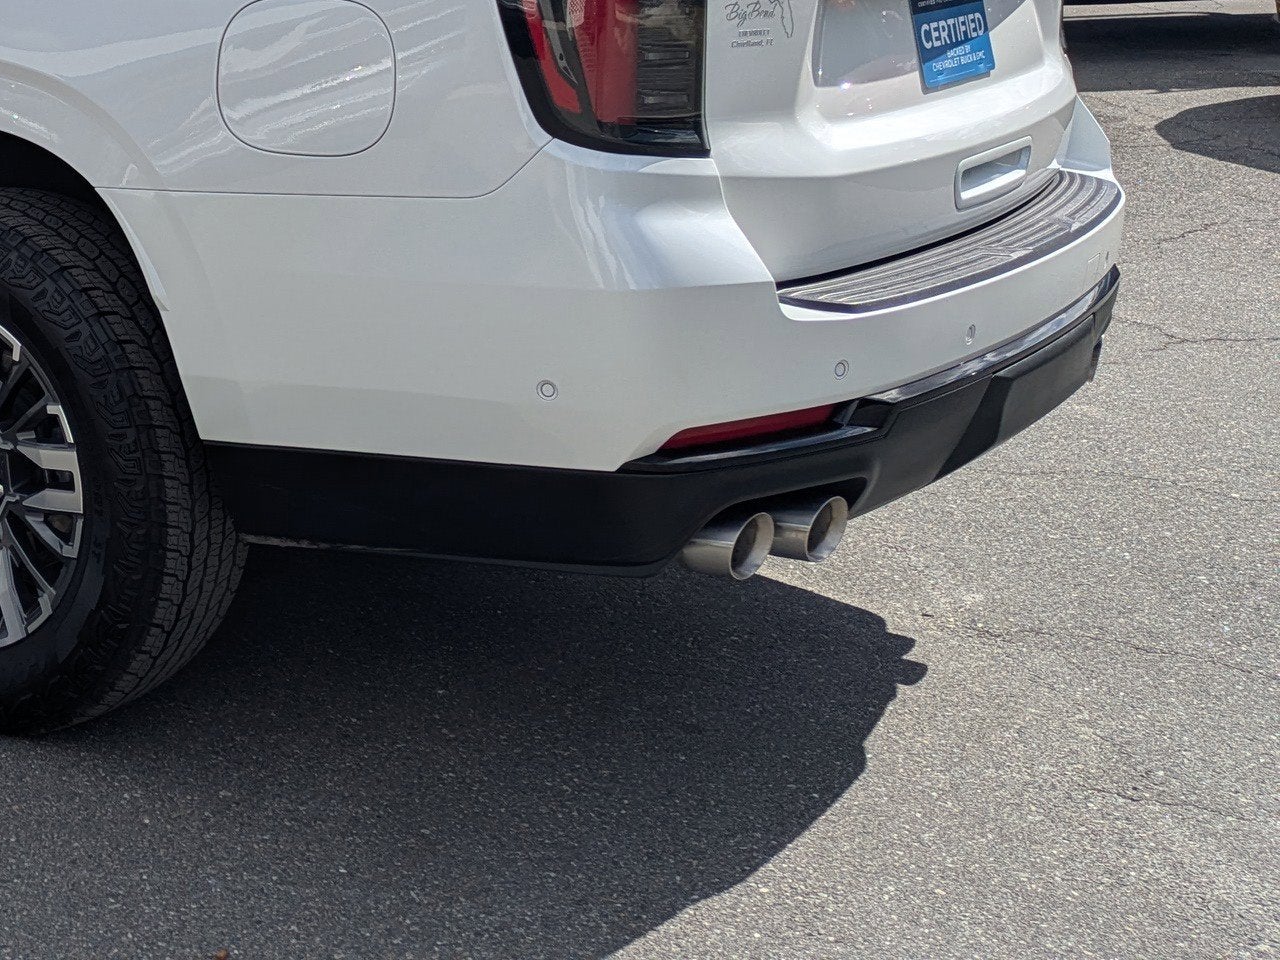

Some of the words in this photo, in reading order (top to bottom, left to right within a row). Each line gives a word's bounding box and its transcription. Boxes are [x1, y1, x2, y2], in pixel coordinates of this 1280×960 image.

[725, 1, 747, 28] Big
[746, 0, 778, 20] Bend
[920, 12, 985, 50] CERTIFIED
